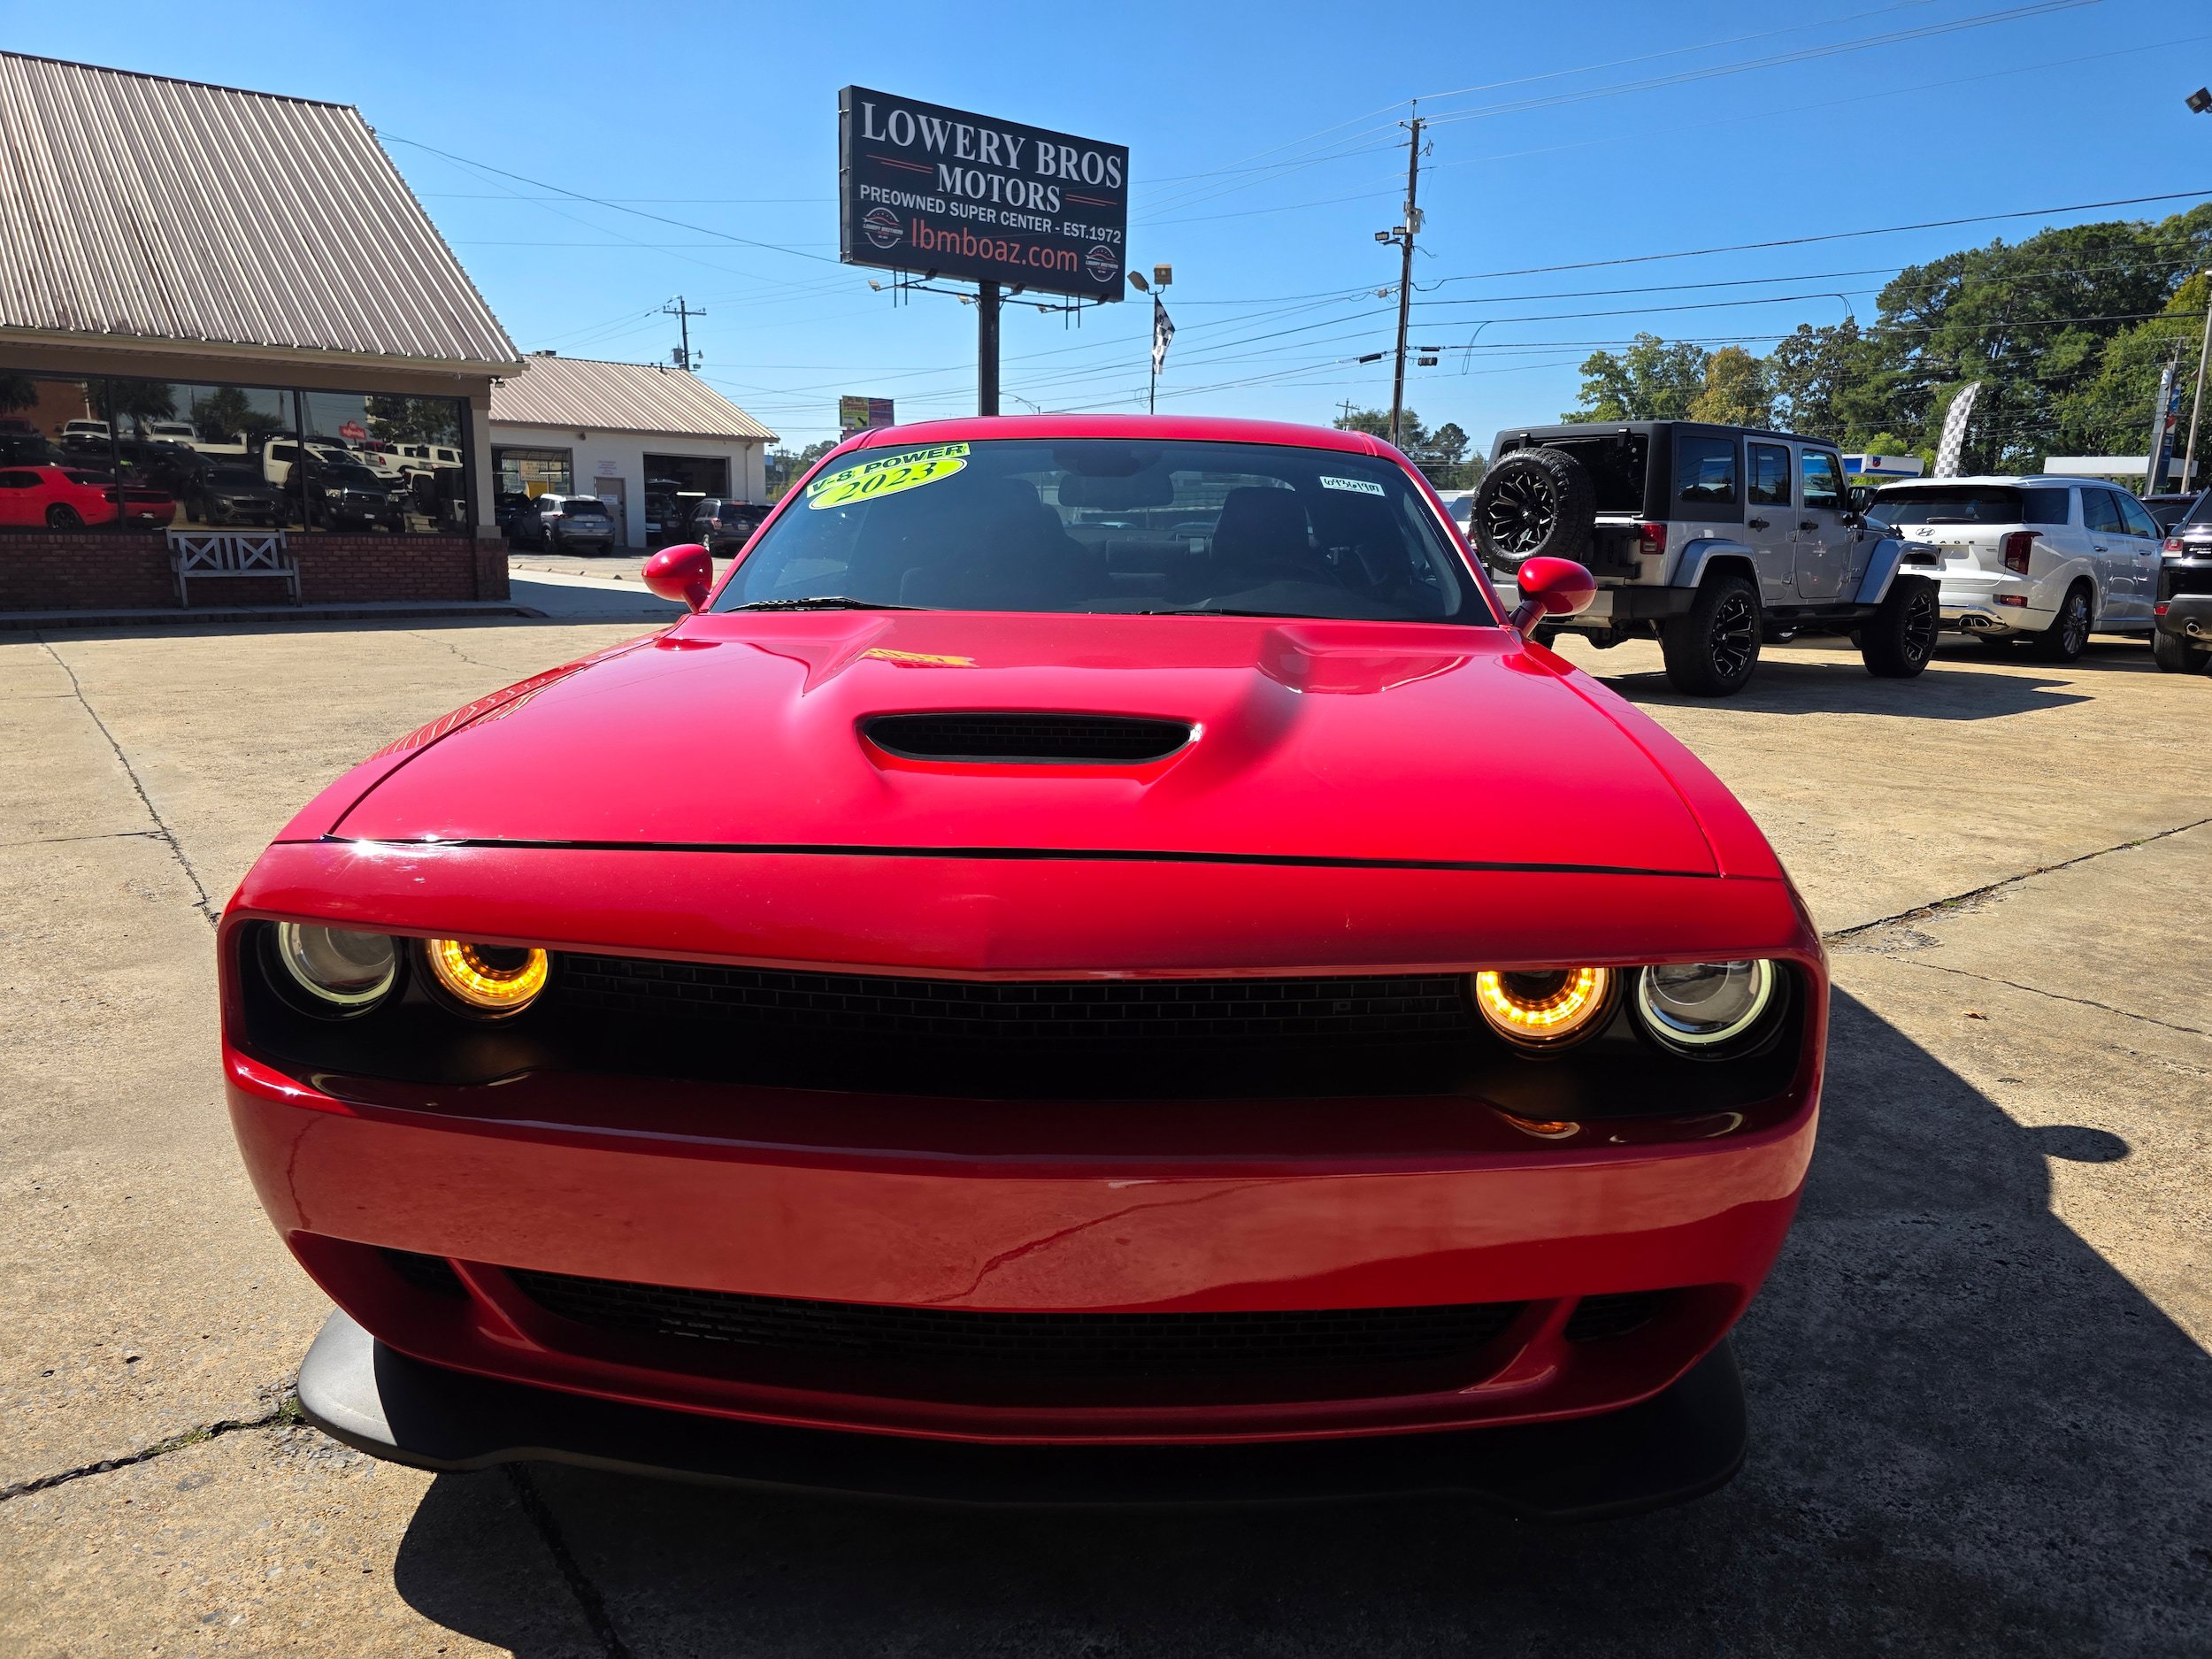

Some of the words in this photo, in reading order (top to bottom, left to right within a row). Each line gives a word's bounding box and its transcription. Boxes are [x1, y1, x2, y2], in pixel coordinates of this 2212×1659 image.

[860, 101, 1025, 171] LOWERY
[1035, 140, 1122, 189] BROS
[860, 184, 946, 214] PREOWNED
[949, 201, 996, 224] SUPER
[1000, 211, 1052, 234] CENTER
[1063, 221, 1122, 244] EST.1972
[936, 163, 1061, 214] MOTORS
[911, 218, 1078, 273] lbmboaz.com
[810, 469, 853, 494] V-8
[864, 444, 965, 474] POWER
[833, 461, 938, 503] 2023
